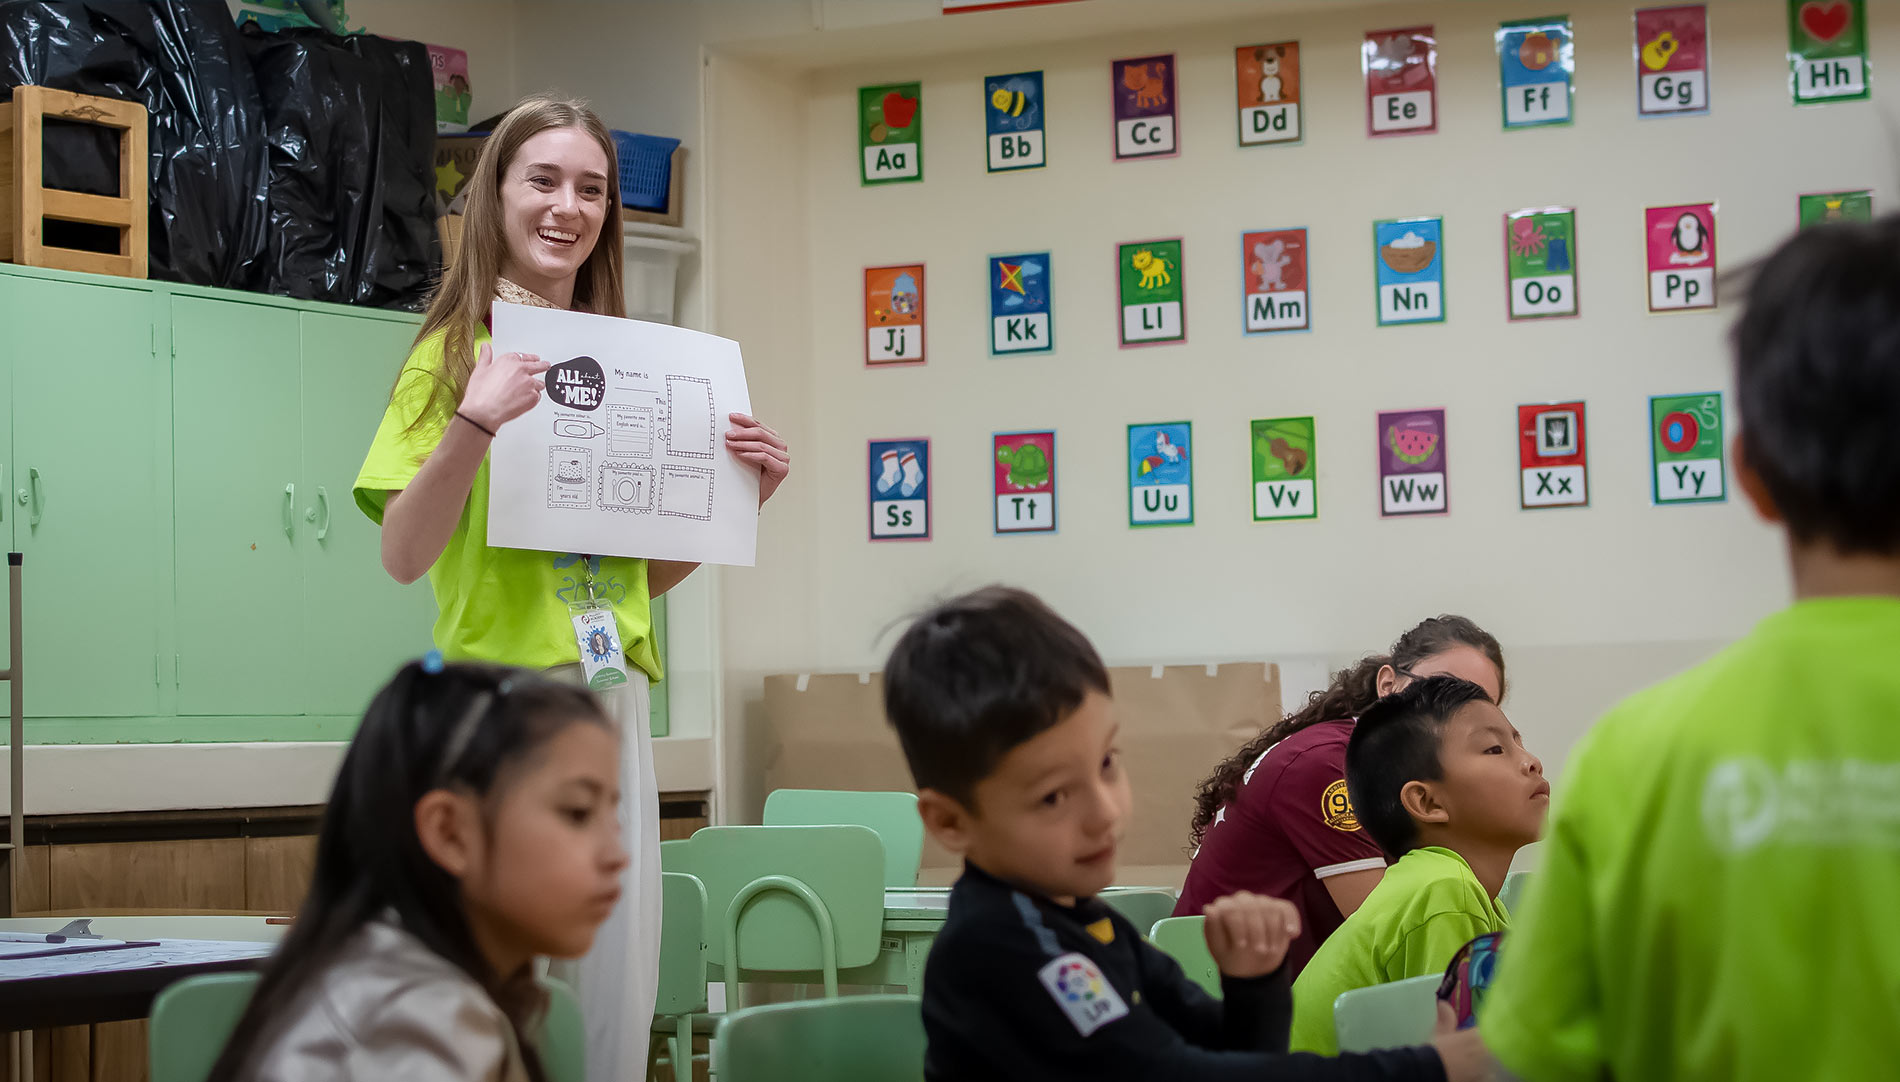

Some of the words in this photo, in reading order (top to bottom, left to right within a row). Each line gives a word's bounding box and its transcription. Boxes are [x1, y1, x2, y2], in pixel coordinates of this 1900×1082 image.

[1810, 61, 1850, 88] Hh
[1523, 86, 1550, 113] Ff
[1653, 76, 1692, 106] Gg
[1253, 107, 1287, 134] Dd
[1387, 96, 1417, 121] Ee
[1131, 121, 1161, 146] Cc
[876, 148, 906, 171] Aa
[1001, 135, 1031, 159] Bb
[1393, 286, 1428, 311] Nn
[1524, 280, 1562, 305] Oo
[1666, 274, 1700, 304] Pp
[1142, 305, 1163, 330] Ll
[1253, 296, 1301, 321] Mm
[1006, 317, 1037, 342] Kk
[884, 328, 905, 357] Jj
[557, 368, 583, 385] ALL
[614, 368, 624, 379] My
[565, 385, 598, 407] ME!
[655, 397, 666, 405] This
[616, 420, 629, 428] English
[1389, 478, 1438, 503] Ww
[1536, 471, 1572, 496] Xx
[1672, 464, 1706, 495] Yy
[1143, 488, 1178, 513] Uu
[1268, 484, 1300, 508] Vv
[886, 504, 913, 527] Ss
[1011, 497, 1037, 521] Tt
